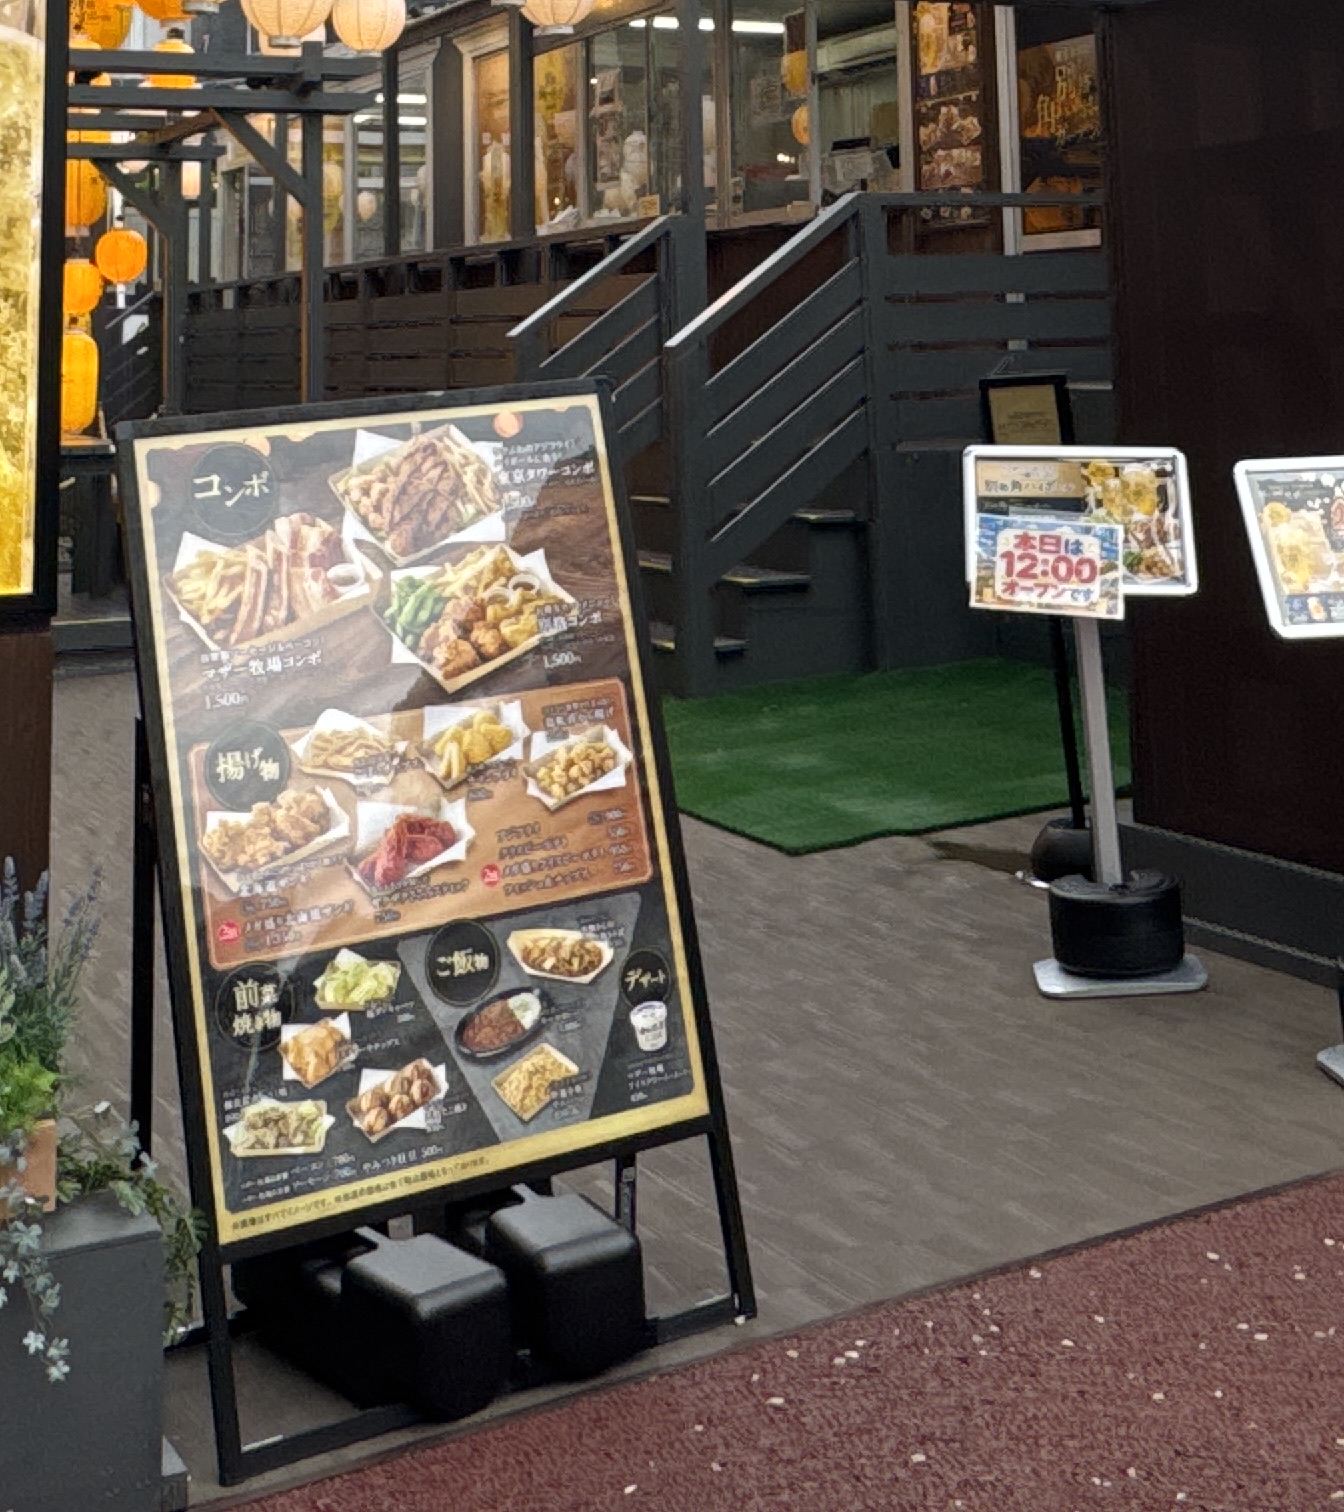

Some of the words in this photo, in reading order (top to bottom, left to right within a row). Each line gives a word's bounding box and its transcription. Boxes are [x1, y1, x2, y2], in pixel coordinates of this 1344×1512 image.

[1012, 531, 1085, 556] 本日は
[998, 550, 1099, 585] 12:00
[1000, 578, 1096, 603] オープンです
[202, 649, 323, 680] マザー牧場コンボ
[215, 746, 281, 784] 揚げ物
